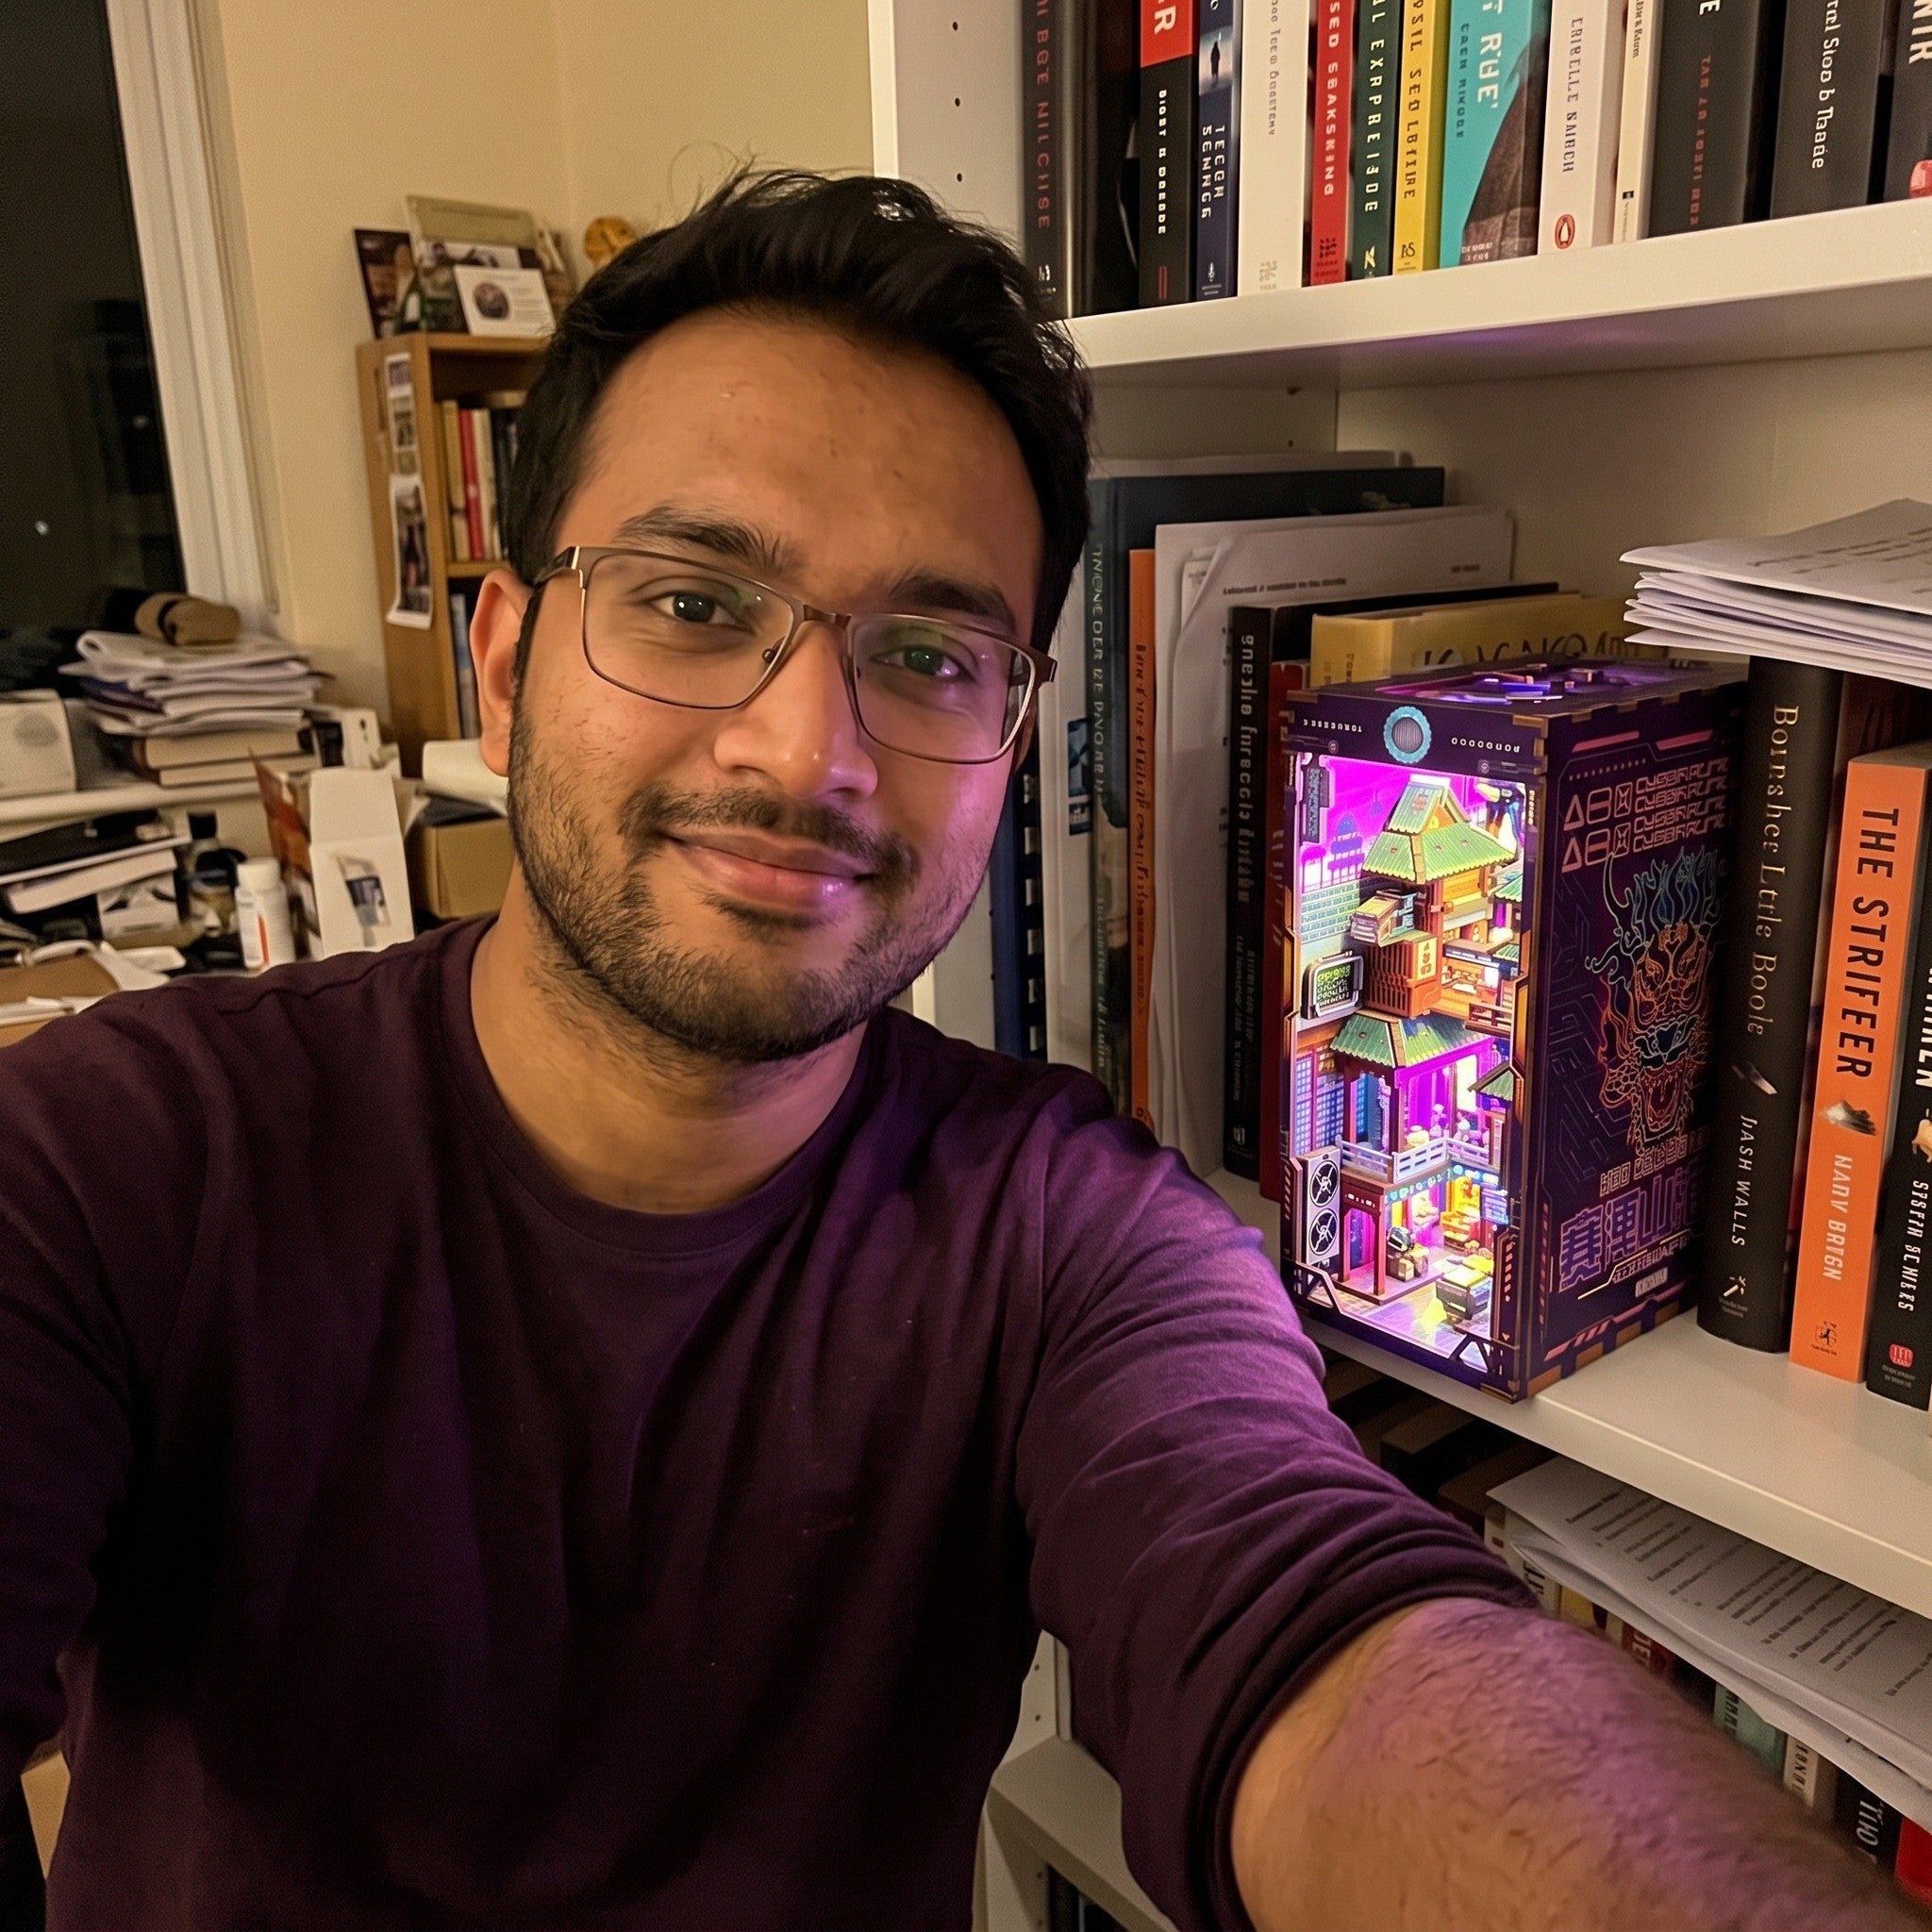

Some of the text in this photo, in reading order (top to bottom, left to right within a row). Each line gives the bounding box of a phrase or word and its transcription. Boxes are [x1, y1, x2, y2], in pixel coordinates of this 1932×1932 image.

[1154, 0, 1176, 35] R
[1836, 808, 1900, 1078] THE STRIFEER
[1731, 1178, 1755, 1247] WALLS
